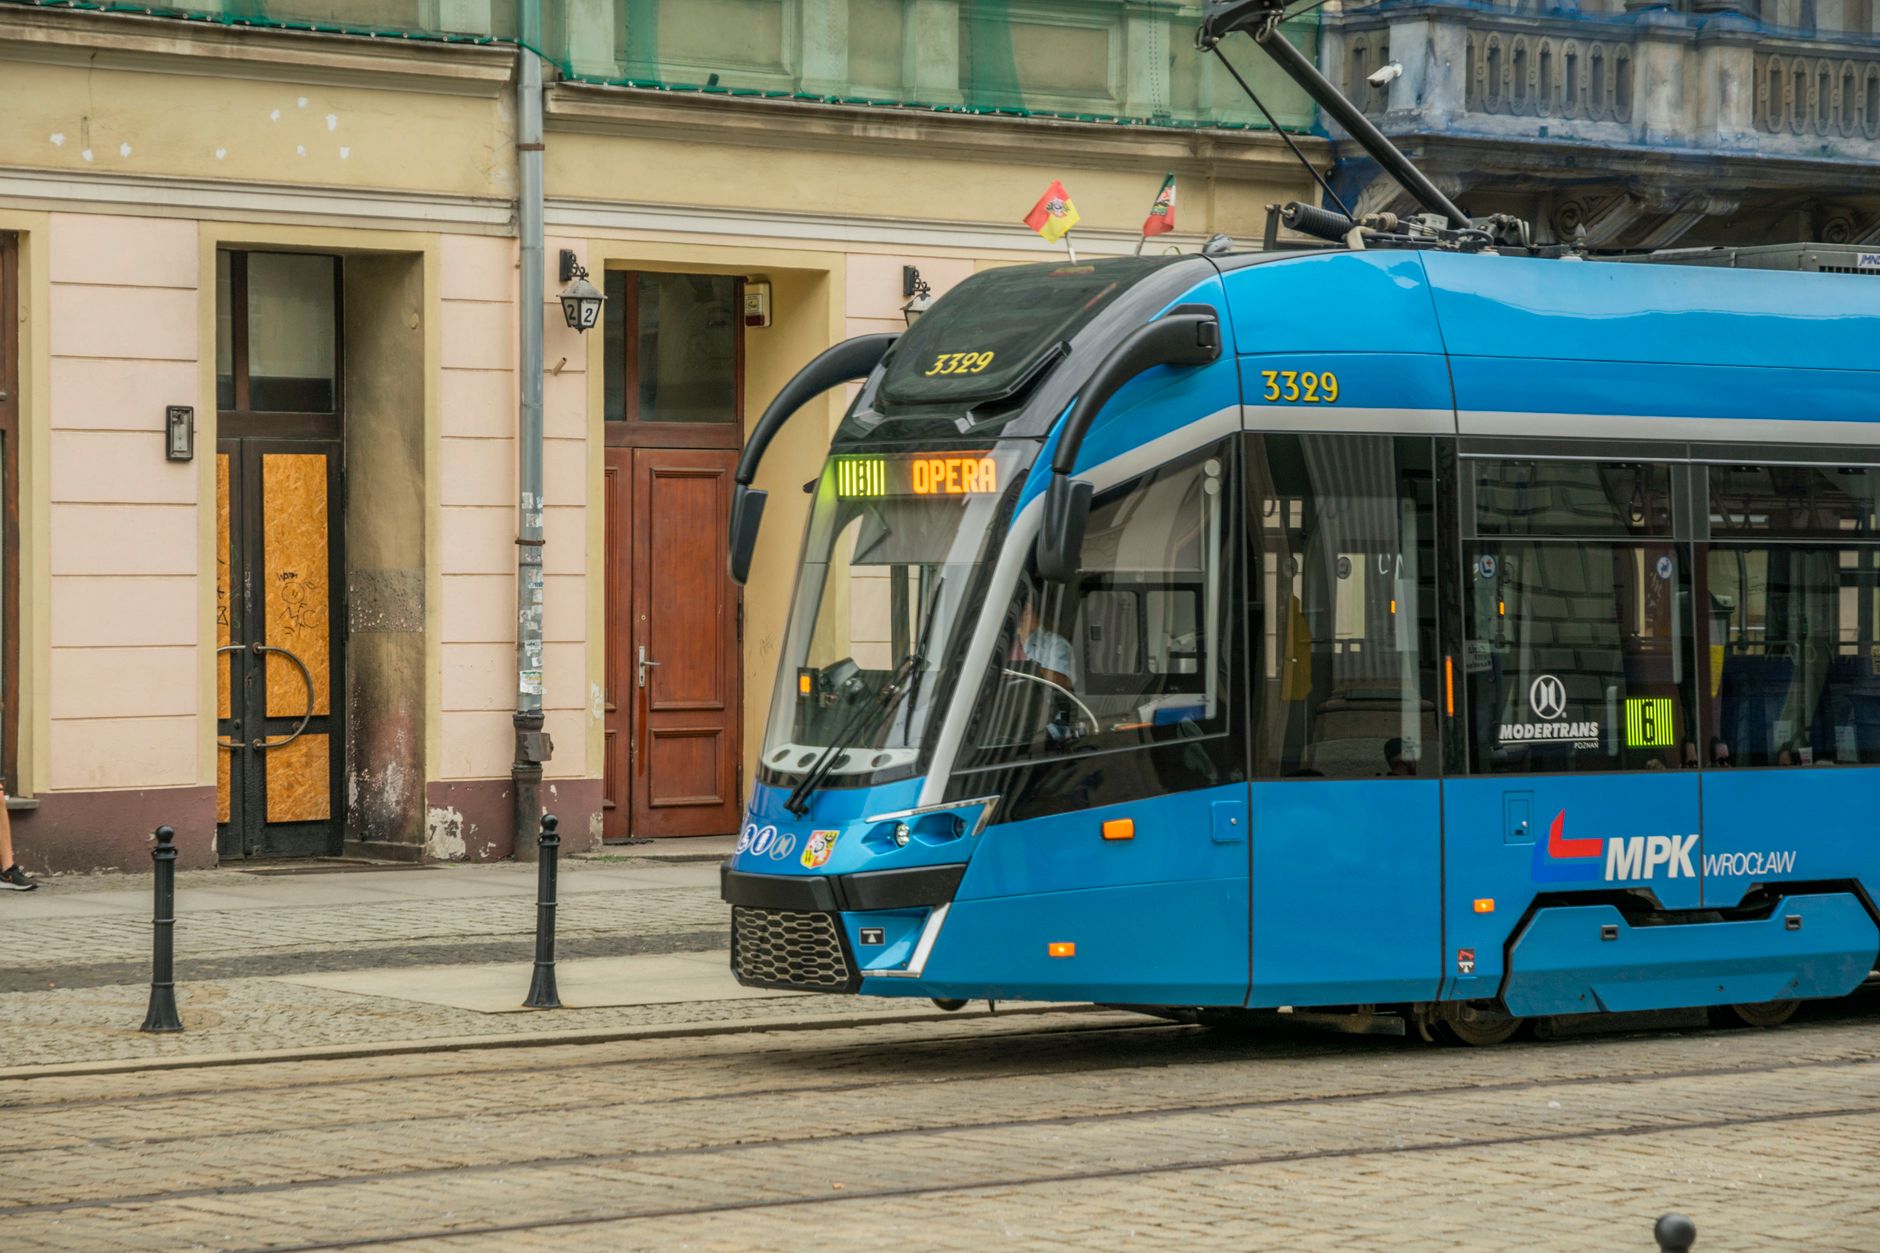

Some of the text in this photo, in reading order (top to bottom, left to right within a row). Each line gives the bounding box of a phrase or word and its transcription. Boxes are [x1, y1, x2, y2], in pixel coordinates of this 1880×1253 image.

[567, 303, 577, 321] 2
[583, 307, 593, 323] 2
[925, 351, 995, 376] 3329
[1261, 370, 1339, 402] 3329
[912, 458, 997, 494] OPERA
[1499, 721, 1599, 739] MODERTRANS
[1605, 834, 1797, 881] MPK WROCŁAW
